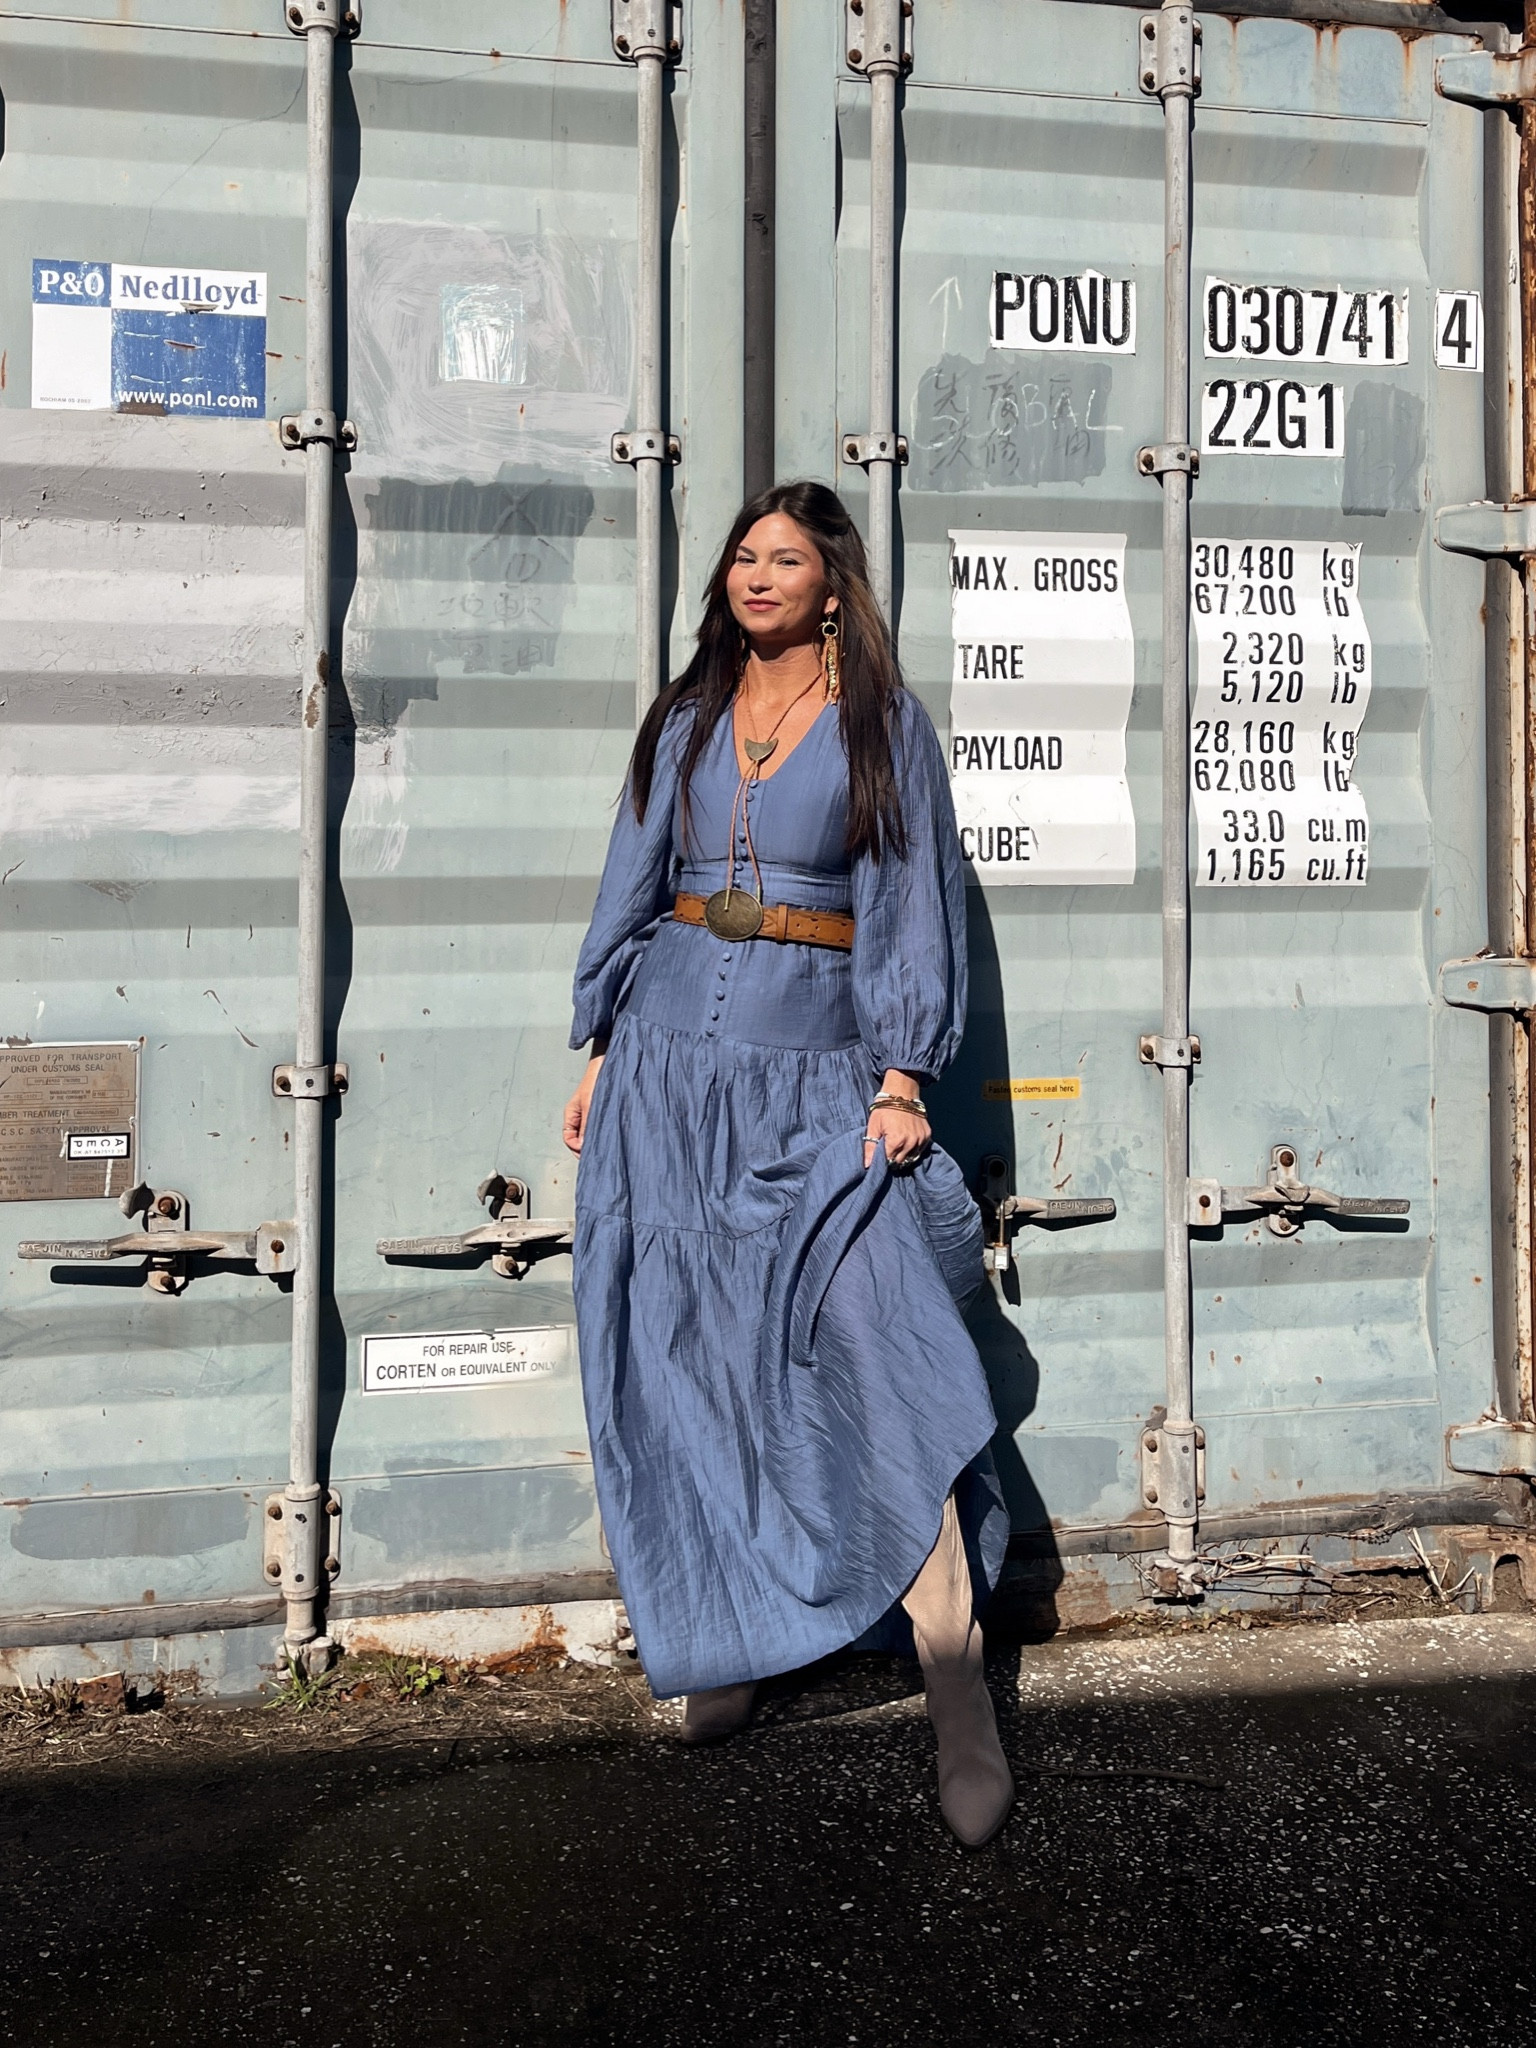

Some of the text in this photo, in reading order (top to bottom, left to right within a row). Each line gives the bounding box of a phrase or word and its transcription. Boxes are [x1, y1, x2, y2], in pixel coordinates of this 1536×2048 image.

[39, 270, 258, 310] P&O Nedlloyd
[996, 273, 1471, 363] PONU 030741 4
[118, 390, 258, 408] www.ponl.com
[1209, 381, 1336, 449] 22G1
[953, 545, 1354, 592] MAX. GROSS 30,480 kg
[1195, 585, 1349, 617] 67,200 lb
[959, 632, 1365, 679] TARE 2,320 kg
[1221, 670, 1357, 704] 5,120 lb
[953, 721, 1354, 770] PAYLOAD 28,160 kg
[1195, 760, 1349, 792] 62,080 lb
[960, 810, 1366, 861] CUBE 33.0 cu.m
[1208, 849, 1366, 882] 1,165 cu.ft
[72, 1053, 122, 1061] TRANSPORT
[382, 1240, 419, 1249] SAEJIN
[424, 1342, 512, 1356] FOR REPAIR USE
[377, 1361, 556, 1379] CORTEN OR EQUIVALENT ONLY
